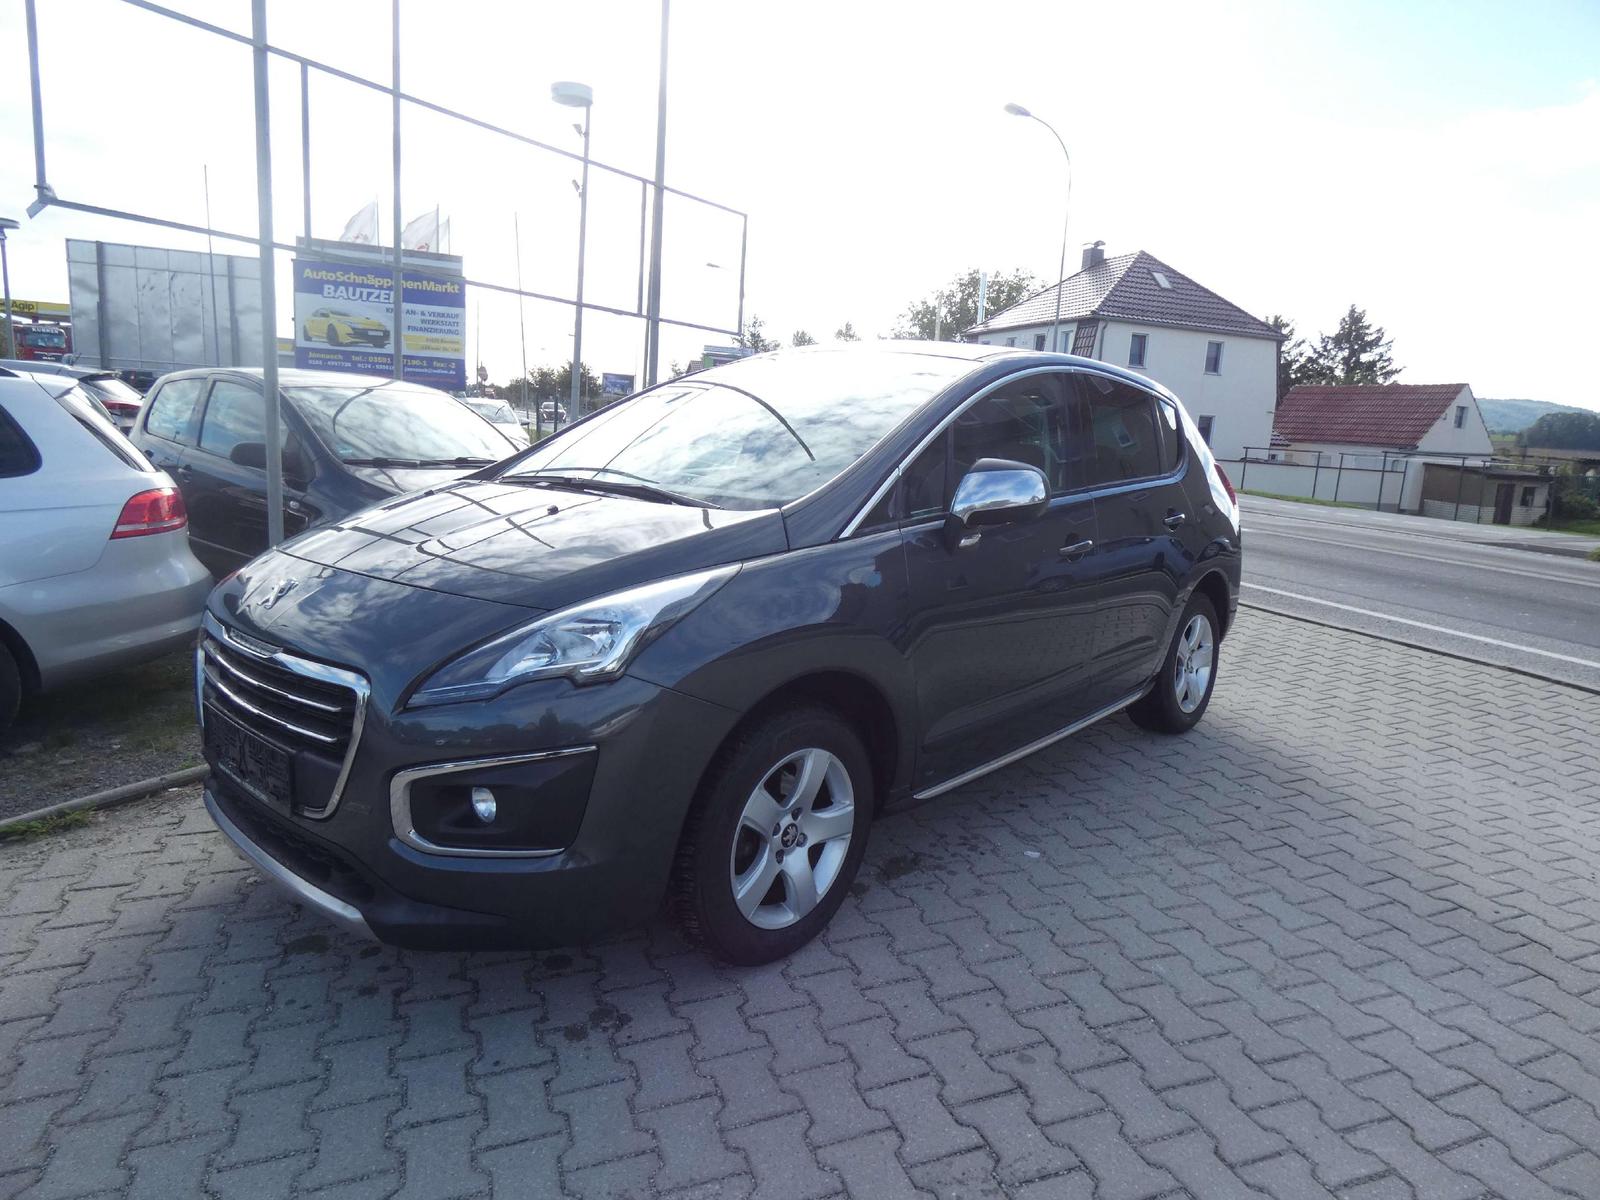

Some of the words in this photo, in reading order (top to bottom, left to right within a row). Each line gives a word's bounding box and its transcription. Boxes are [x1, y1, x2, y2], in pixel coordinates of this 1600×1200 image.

[303, 268, 460, 294] AutoSchnäpphenMarkt
[12, 301, 34, 311] Agip
[427, 311, 460, 319] VERKAUF
[420, 319, 460, 327] WERKSTATT
[407, 325, 460, 335] FINANZIERUNG
